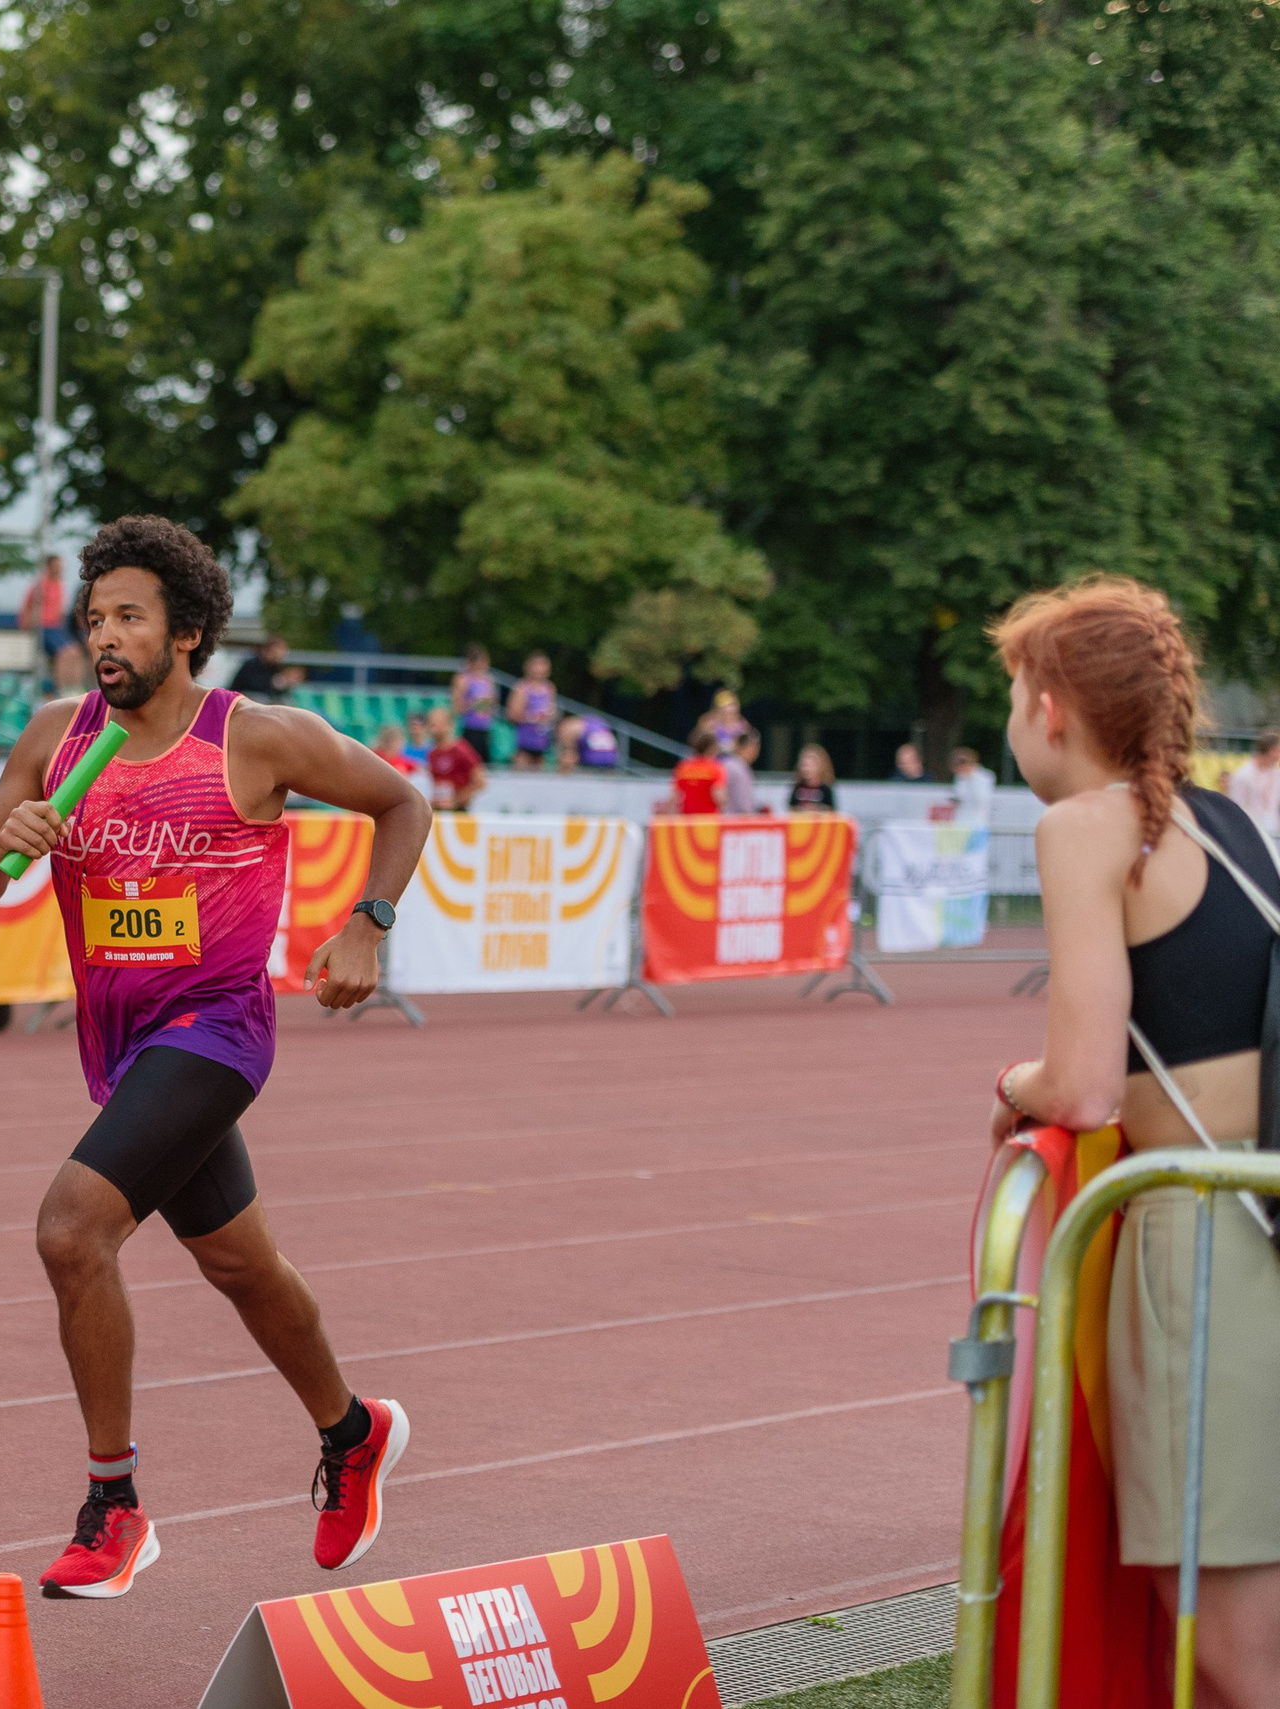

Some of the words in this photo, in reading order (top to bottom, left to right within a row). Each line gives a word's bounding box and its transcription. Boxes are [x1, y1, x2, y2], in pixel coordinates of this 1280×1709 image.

[109, 908, 162, 938] 206
[175, 920, 185, 936] 2
[105, 951, 113, 960] 2й
[114, 953, 128, 961] этап
[129, 953, 145, 961] 1200
[147, 952, 174, 962] метров
[438, 1584, 547, 1659] БИТВА
[461, 1647, 561, 1706] БЕГОВЫХ
